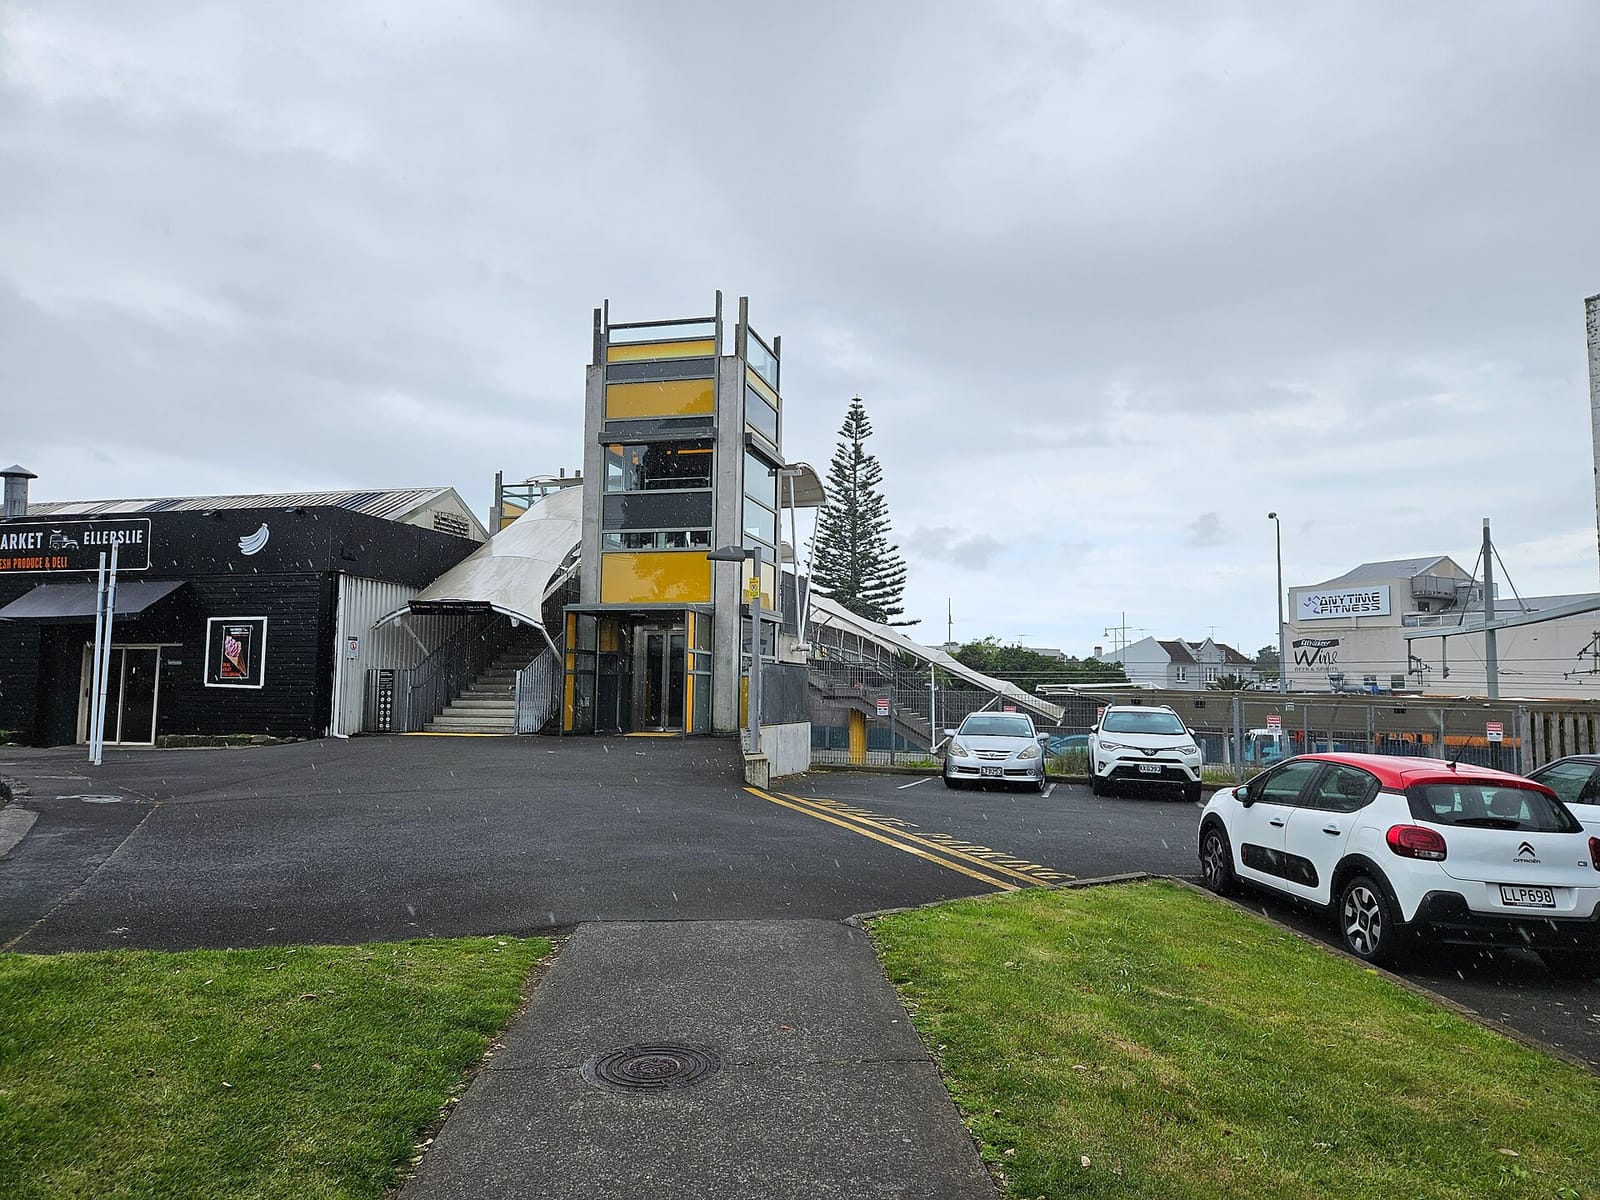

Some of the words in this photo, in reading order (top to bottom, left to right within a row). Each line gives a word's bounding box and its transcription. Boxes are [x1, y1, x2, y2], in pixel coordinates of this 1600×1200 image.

[83, 530, 143, 545] ELLERSLIE
[13, 557, 43, 569] PRODUCE
[45, 556, 50, 568] &
[52, 556, 68, 568] DELI
[1319, 591, 1380, 606] ANYTIME
[1320, 602, 1380, 614] FITNESS
[1294, 647, 1338, 667] Wine
[1502, 887, 1552, 903] LLP698
